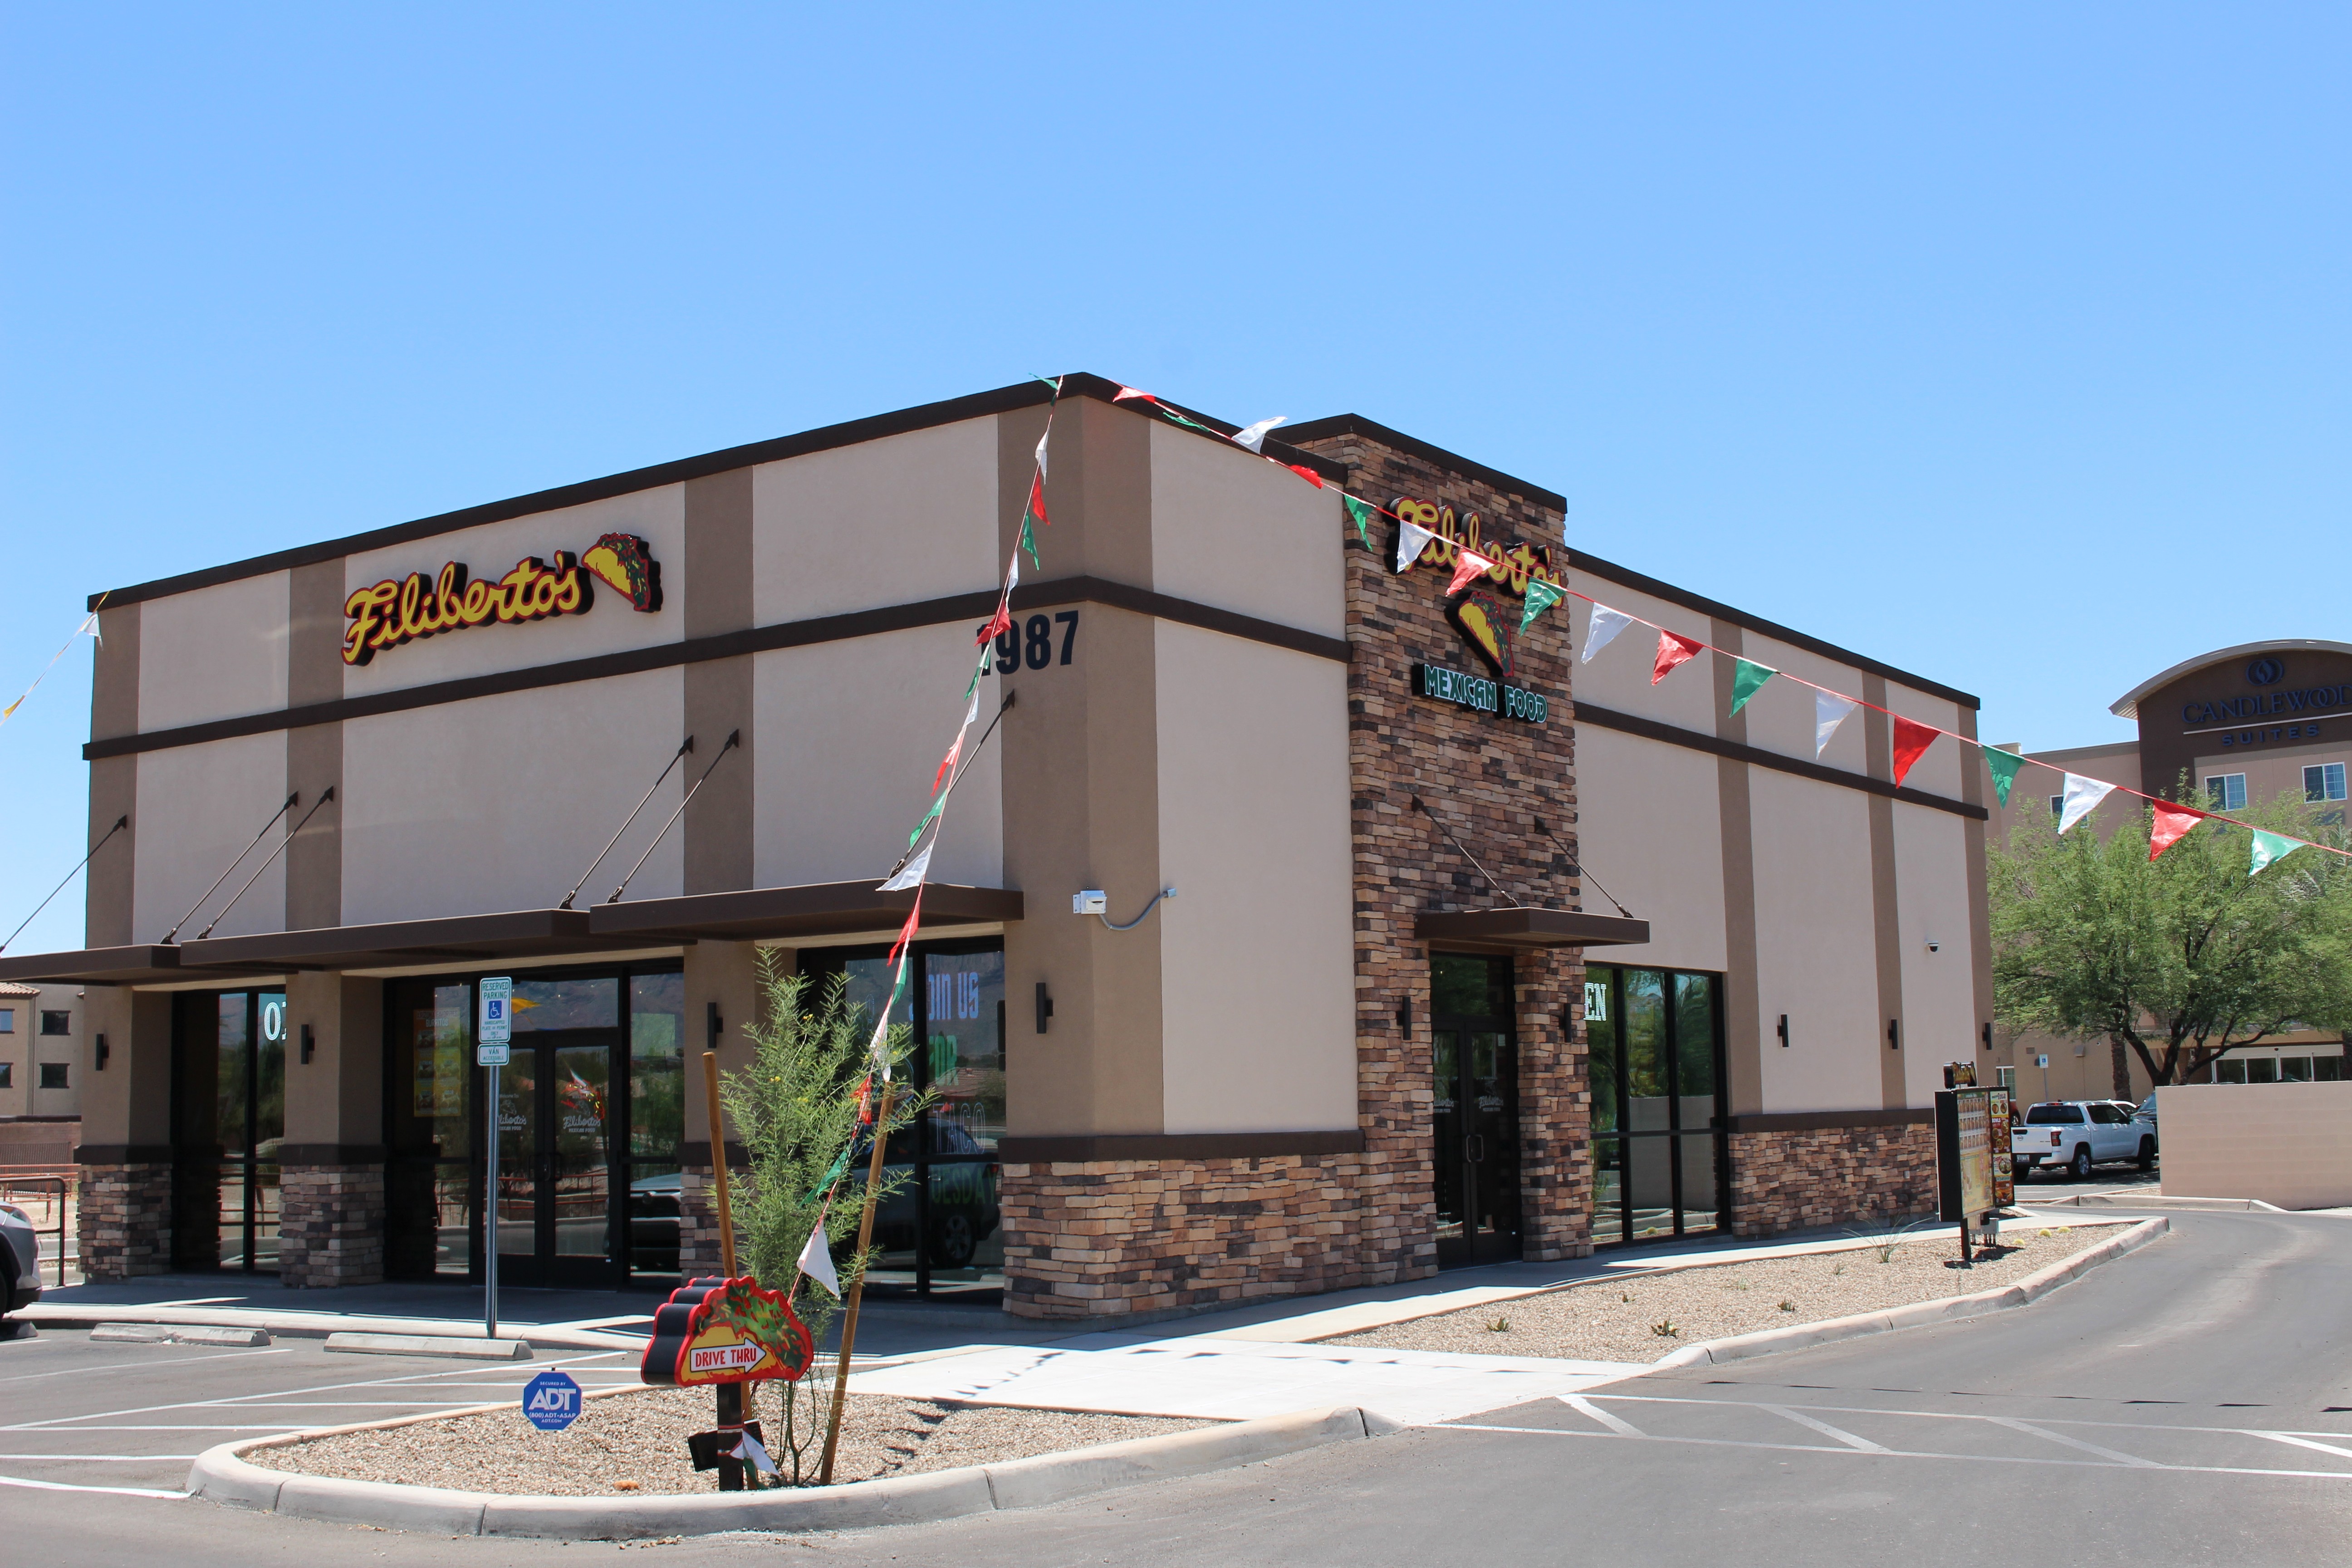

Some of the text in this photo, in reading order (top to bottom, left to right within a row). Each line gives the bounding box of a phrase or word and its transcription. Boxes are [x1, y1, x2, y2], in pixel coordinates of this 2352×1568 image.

[341, 550, 585, 665] Filiberto's
[1424, 664, 1548, 723] MEXICAN FOOD
[2222, 725, 2319, 746] SUITES
[482, 982, 509, 991] RESERVED
[484, 991, 507, 1000] PARKING
[957, 972, 980, 1019] US
[1583, 982, 1607, 1021] EN
[499, 1113, 527, 1125] liberto's
[563, 1115, 601, 1129] Filiberto's
[933, 1102, 986, 1155] TACO
[931, 1166, 997, 1205] UESDAY
[696, 1348, 756, 1367] DRIVE THRU
[528, 1388, 577, 1411] ADT
